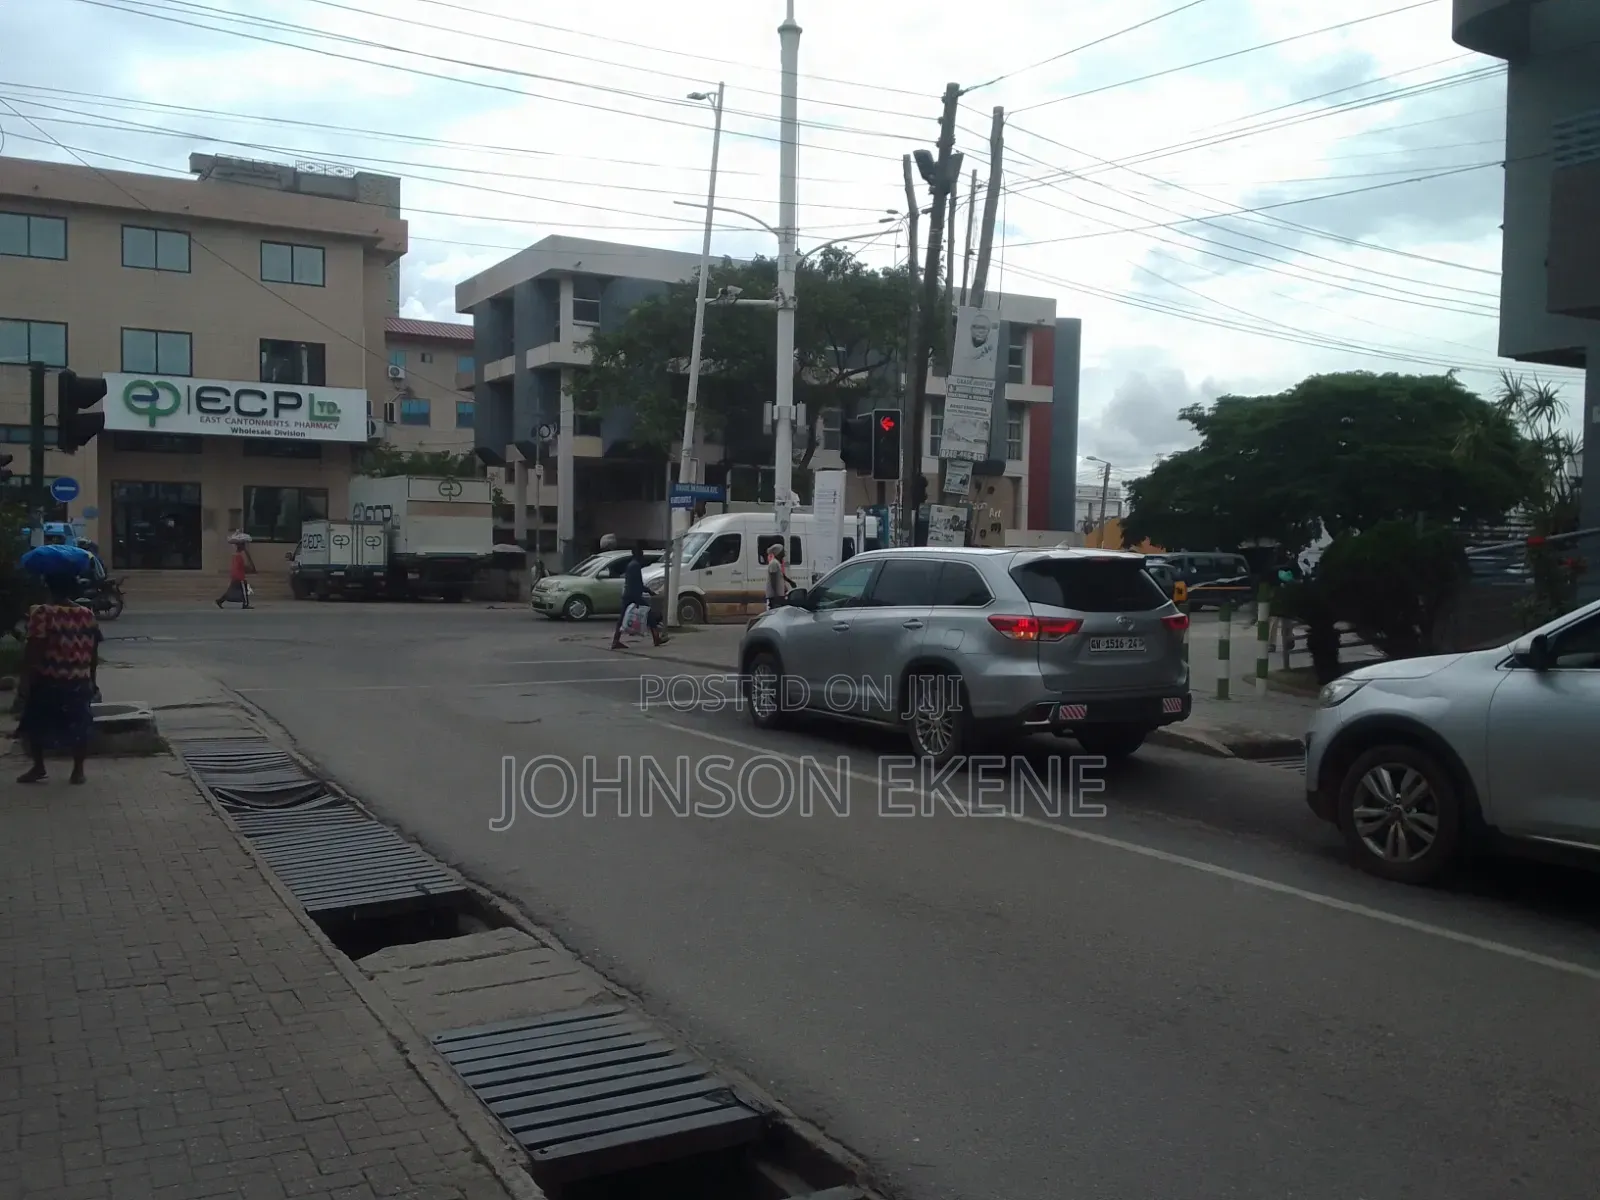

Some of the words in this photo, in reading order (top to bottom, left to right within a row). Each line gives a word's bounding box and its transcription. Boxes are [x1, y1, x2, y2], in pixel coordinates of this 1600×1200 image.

[195, 385, 302, 418] ECP
[200, 415, 221, 424] EAST
[294, 421, 339, 430] PHARMACY
[230, 426, 271, 436] Wholesale
[274, 428, 306, 438] Division
